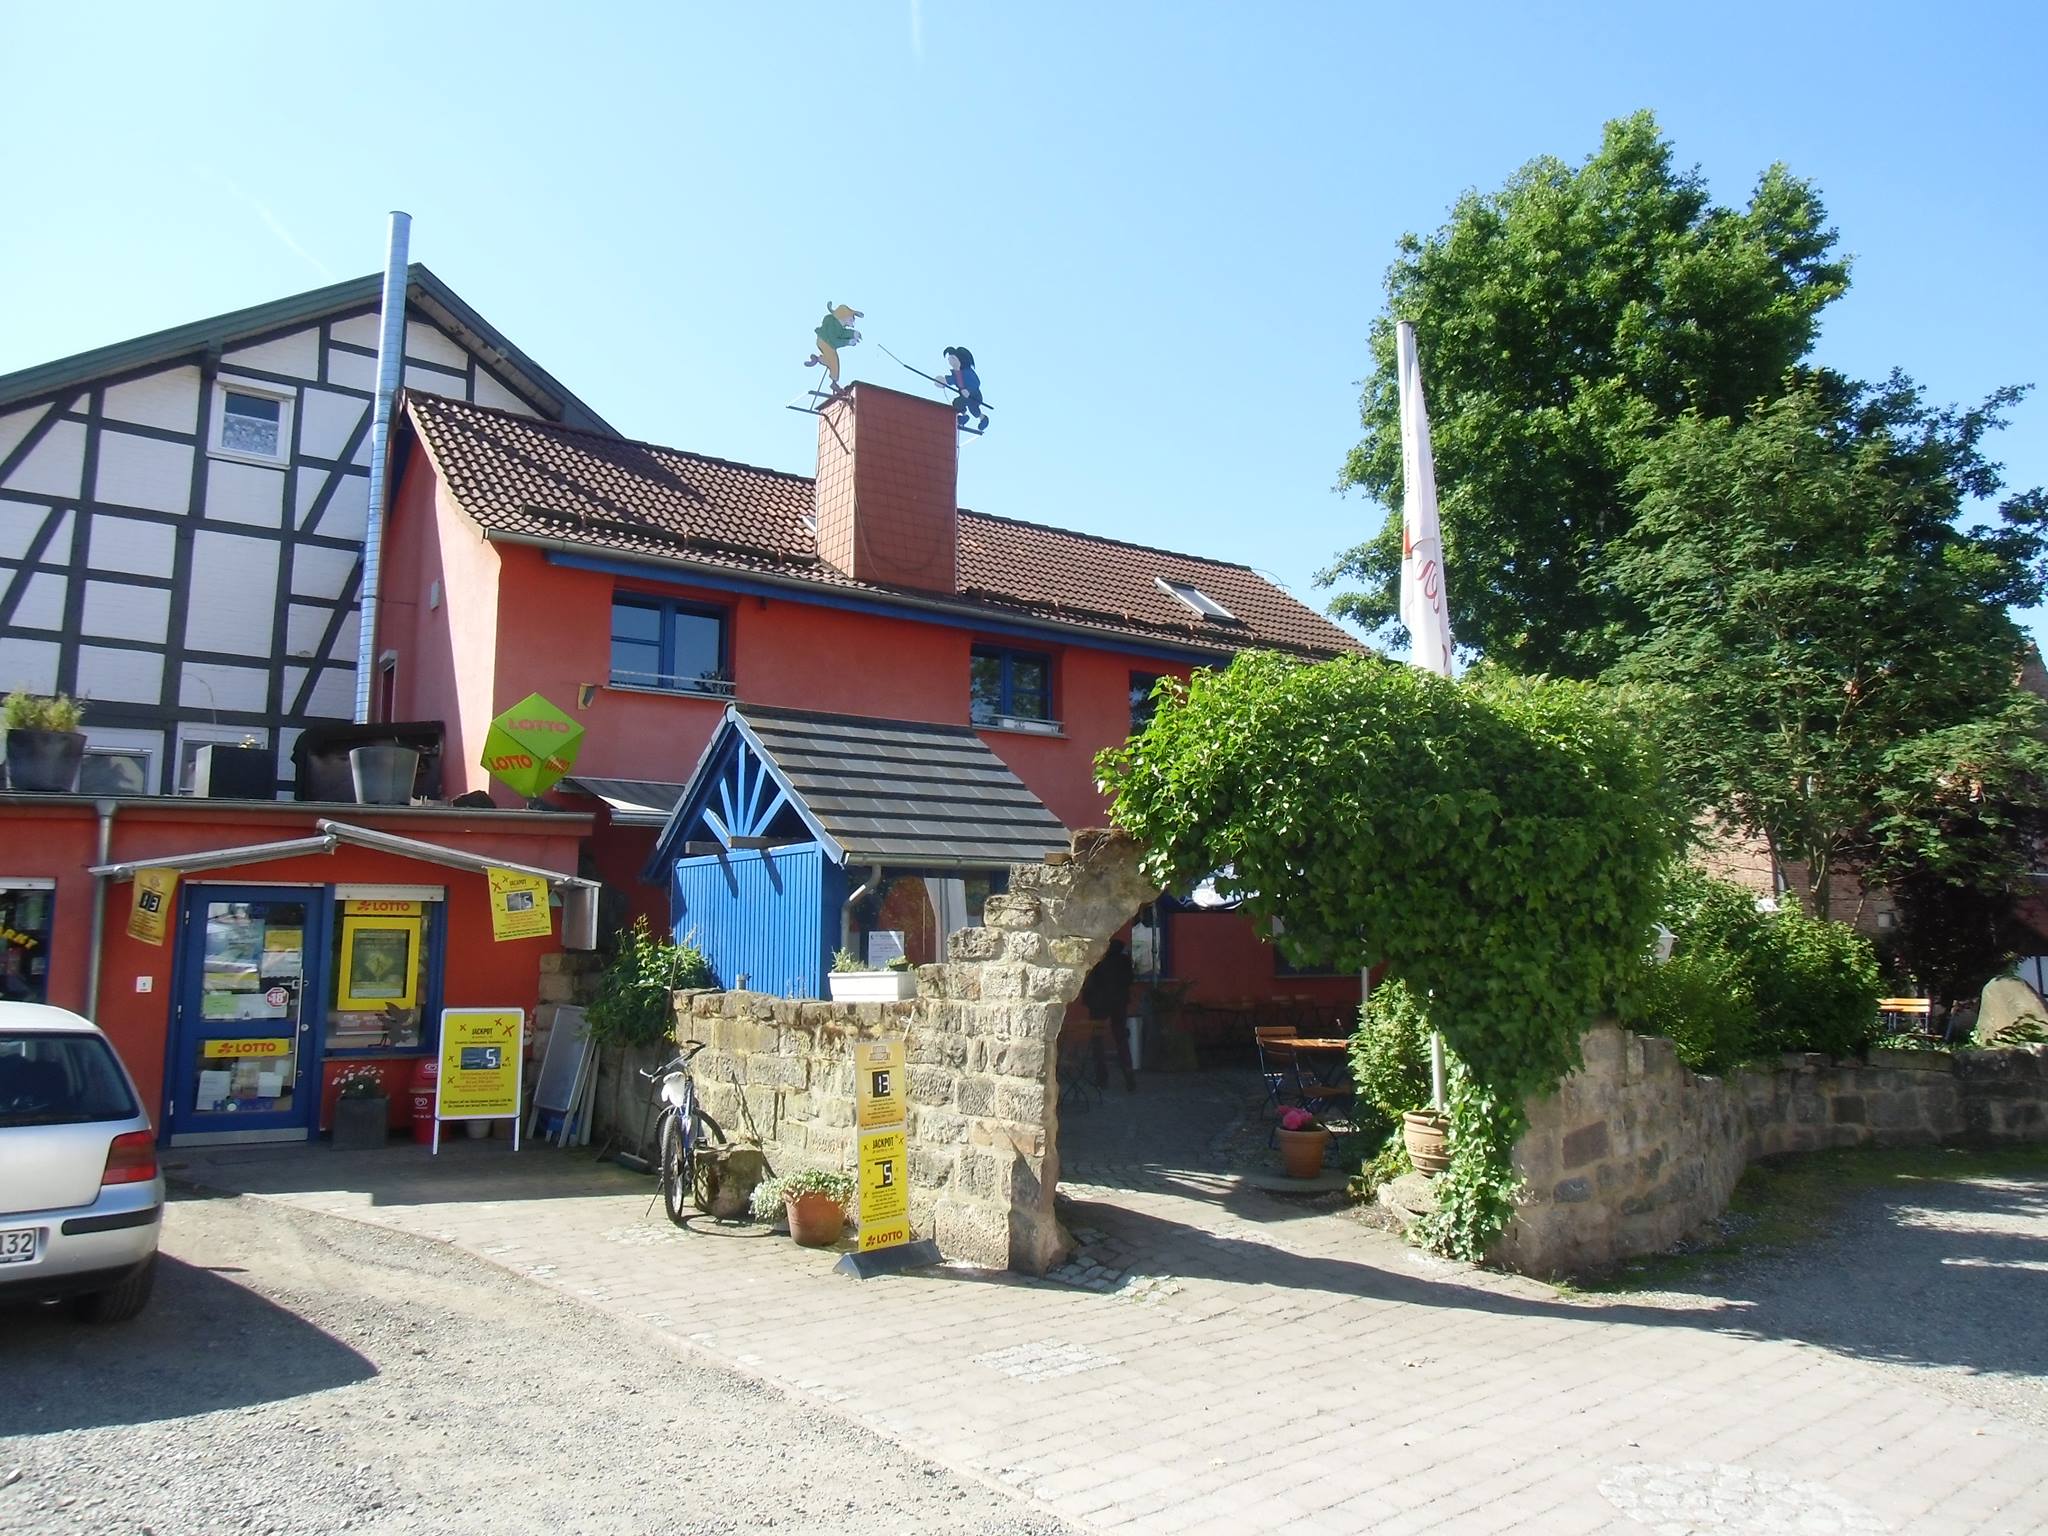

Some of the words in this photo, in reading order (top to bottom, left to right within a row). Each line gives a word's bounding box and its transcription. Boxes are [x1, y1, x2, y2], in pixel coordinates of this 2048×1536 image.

[507, 717, 570, 733] LOTTO
[488, 754, 533, 771] LOTTO
[143, 894, 159, 911] 13
[372, 902, 410, 911] LOTTO
[523, 895, 532, 908] 5
[236, 1043, 276, 1053] LOTTO
[486, 1049, 496, 1067] 5
[878, 1074, 890, 1093] 13
[872, 1136, 894, 1150] JACKPOT
[884, 1163, 892, 1184] 5
[876, 1230, 903, 1244] LOTTO
